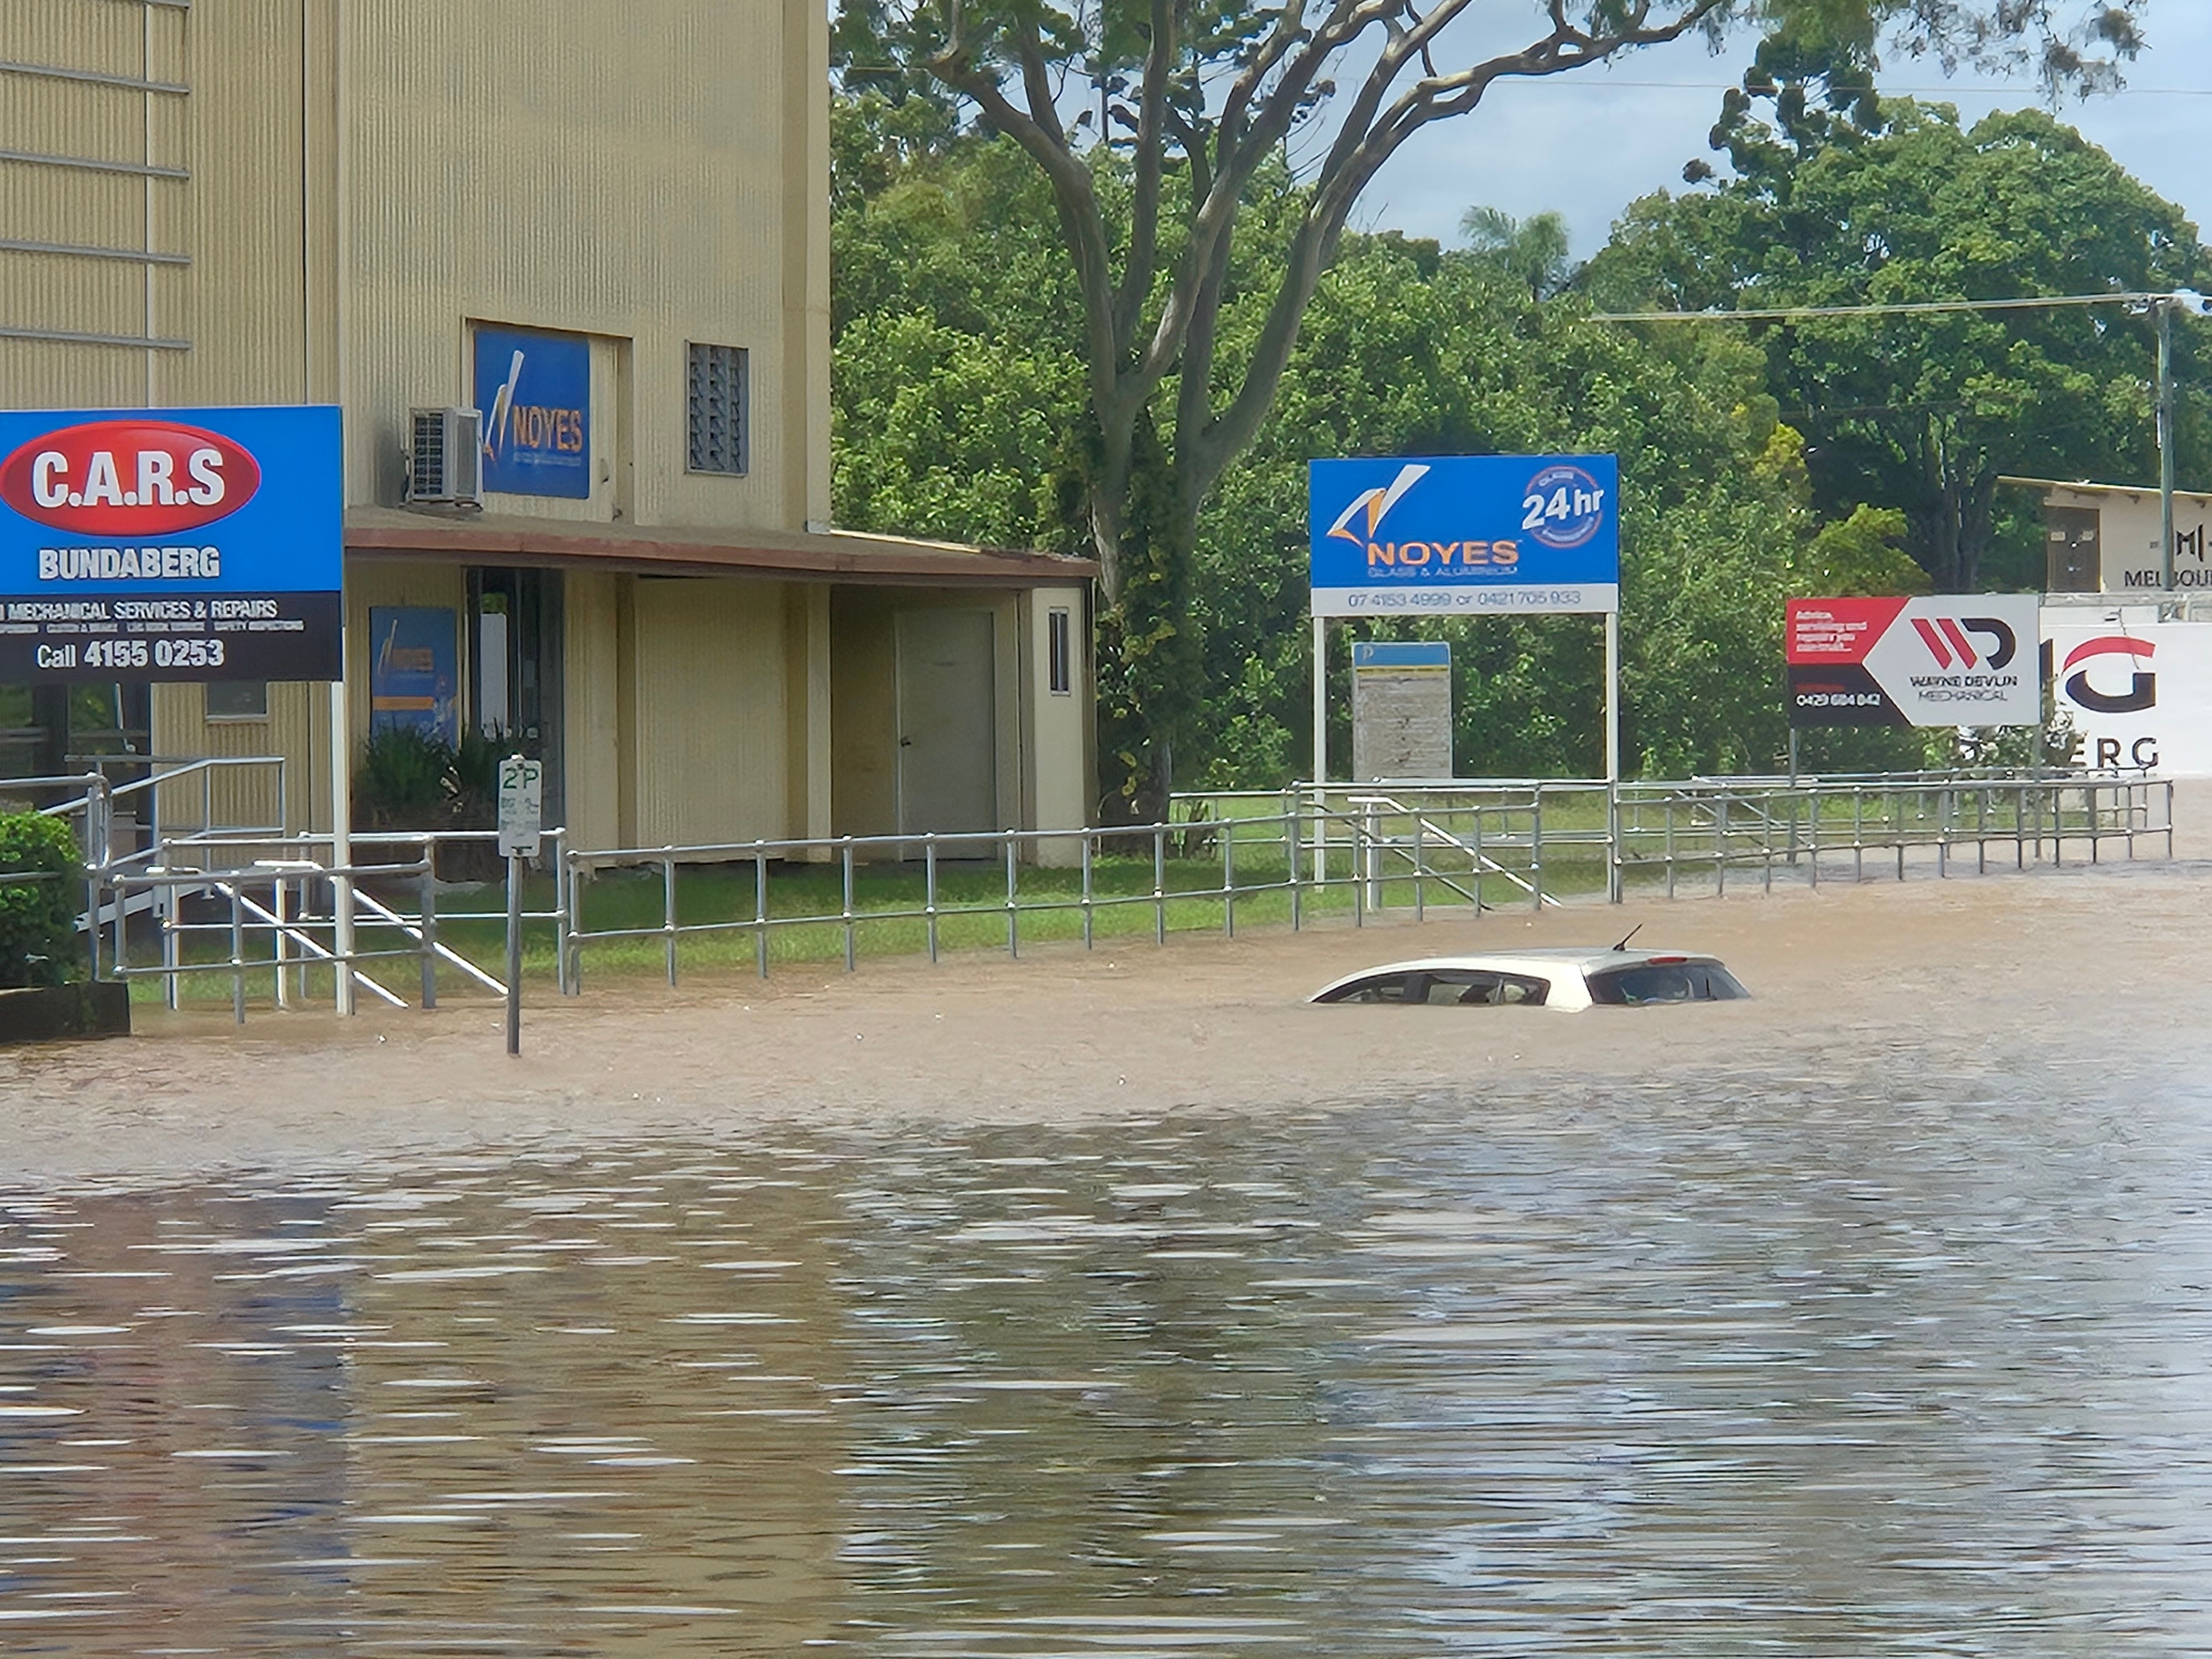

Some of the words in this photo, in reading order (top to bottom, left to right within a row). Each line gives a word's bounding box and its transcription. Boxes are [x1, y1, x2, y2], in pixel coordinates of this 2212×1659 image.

[513, 405, 582, 452] NOYES
[32, 449, 225, 508] C.A.R.S
[39, 546, 220, 580] BUNDABERG
[1367, 540, 1519, 566] NOYES
[8, 602, 111, 620] MECHANICAL
[114, 601, 191, 620] SERVICES
[194, 601, 207, 618] &
[211, 599, 278, 618] REPAIRS
[1348, 594, 1367, 607] 07
[1457, 595, 1473, 605] or
[37, 644, 76, 668] Call
[84, 640, 148, 667] 4155
[155, 639, 224, 667] 0253
[503, 767, 539, 789] 2P
